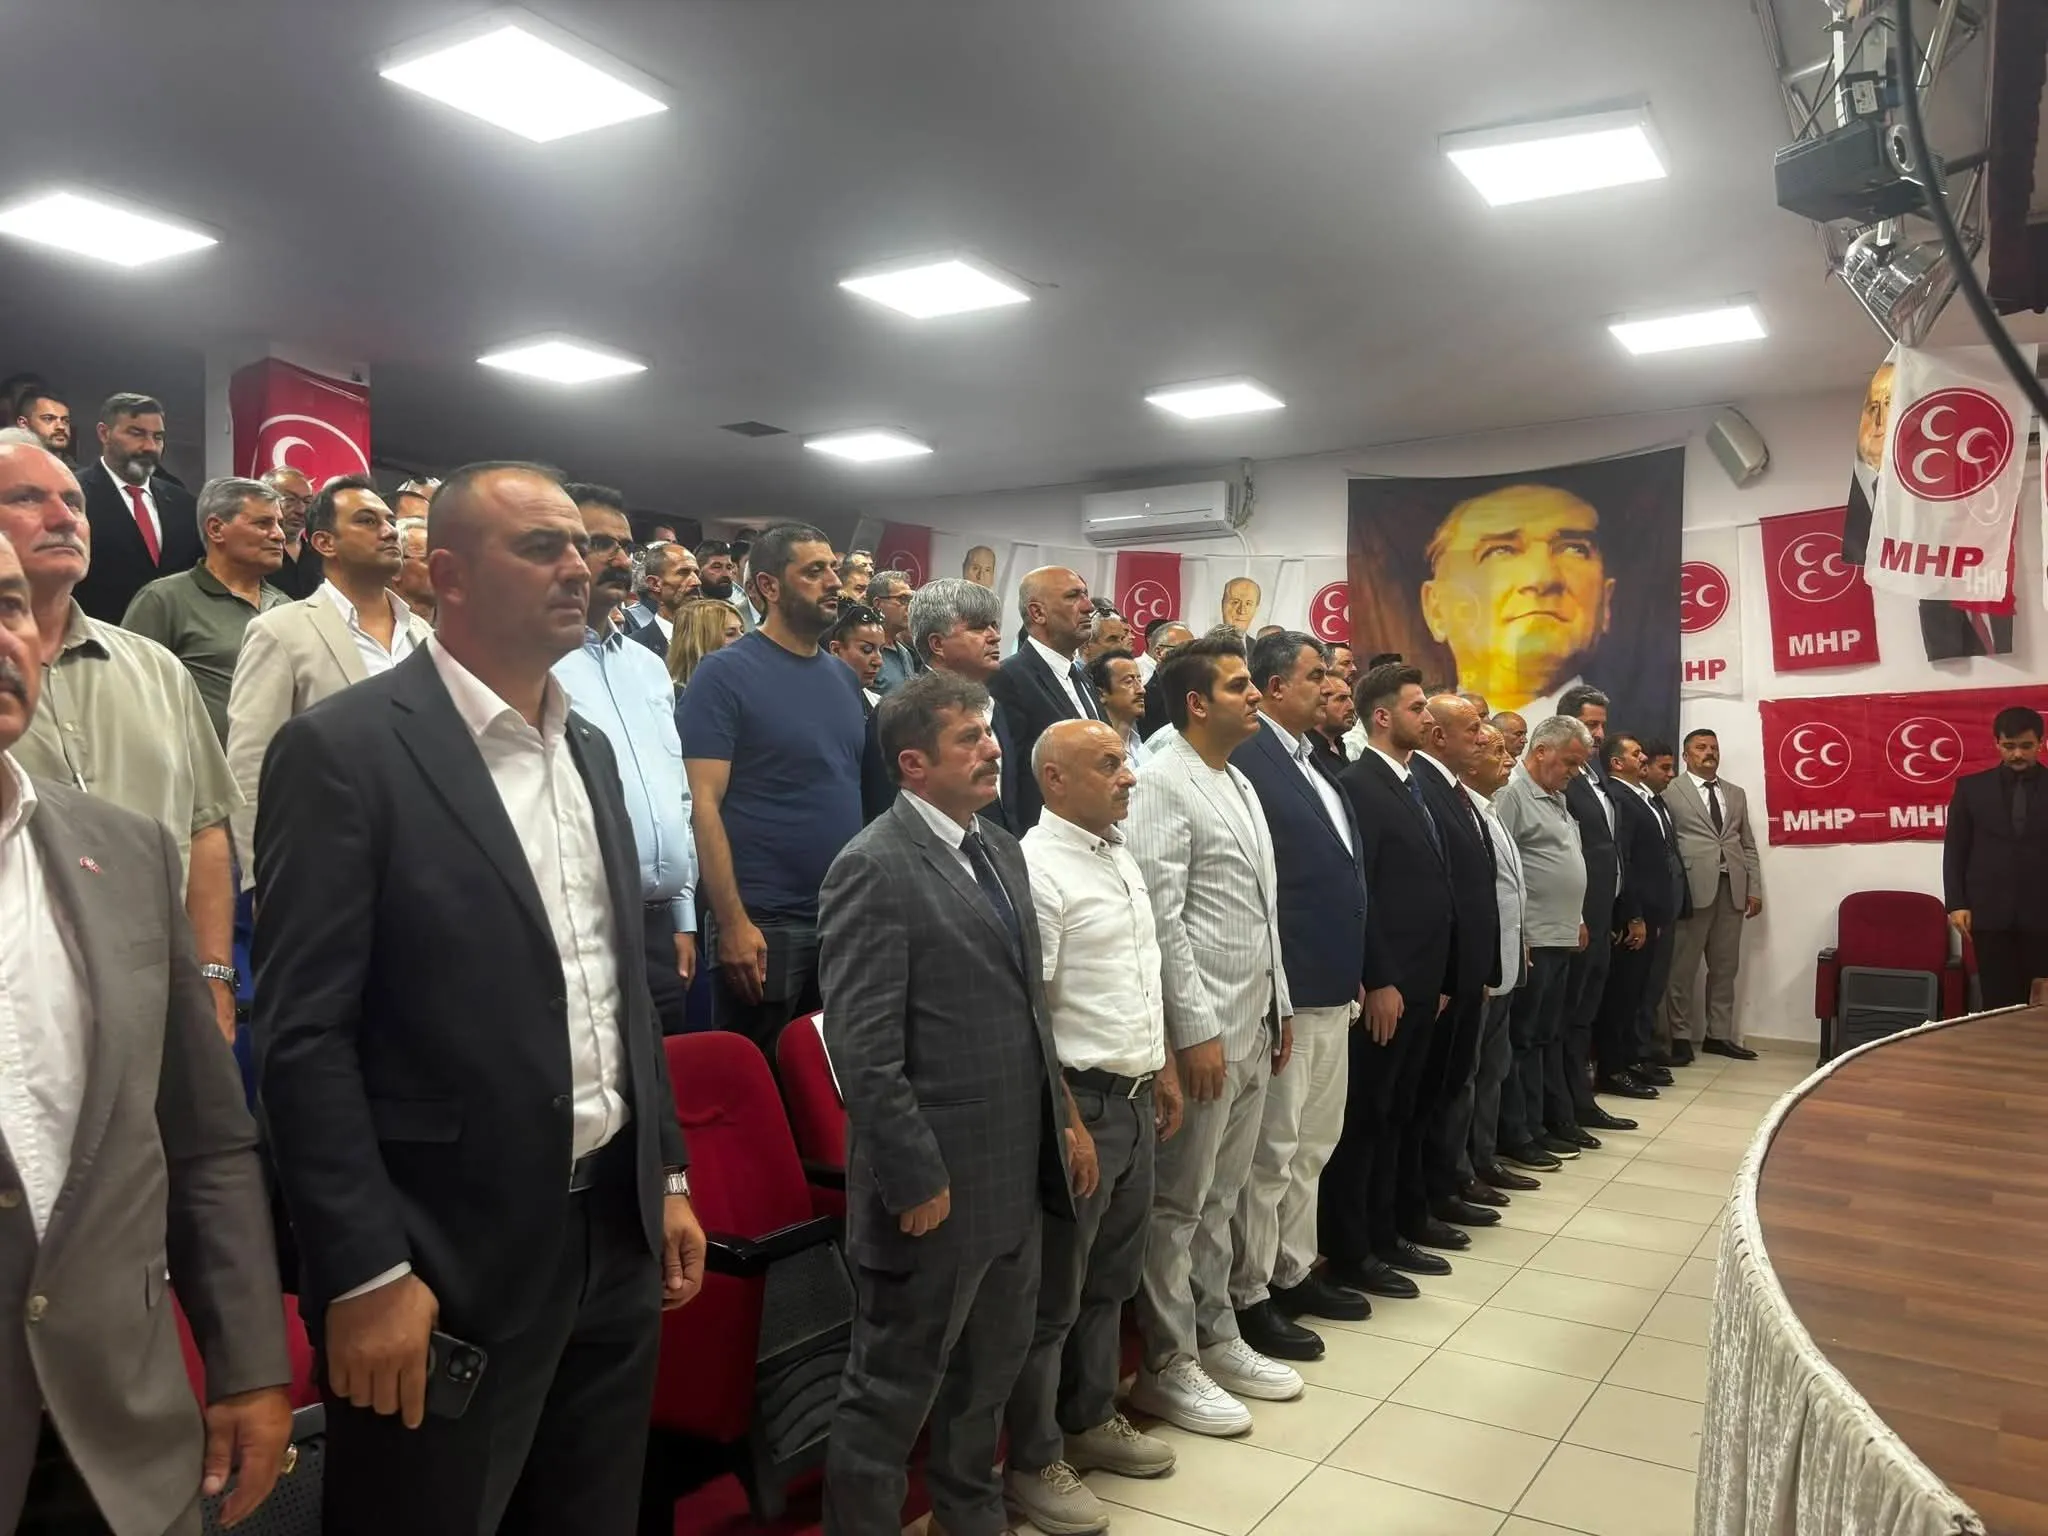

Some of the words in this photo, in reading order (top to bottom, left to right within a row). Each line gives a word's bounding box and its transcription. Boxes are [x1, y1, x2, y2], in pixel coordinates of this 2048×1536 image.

[1879, 537, 1984, 578] MHP
[1788, 629, 1861, 657] MHP
[1681, 658, 1727, 682] HP
[1782, 808, 1856, 832] MHP
[1889, 804, 1949, 828] MH
